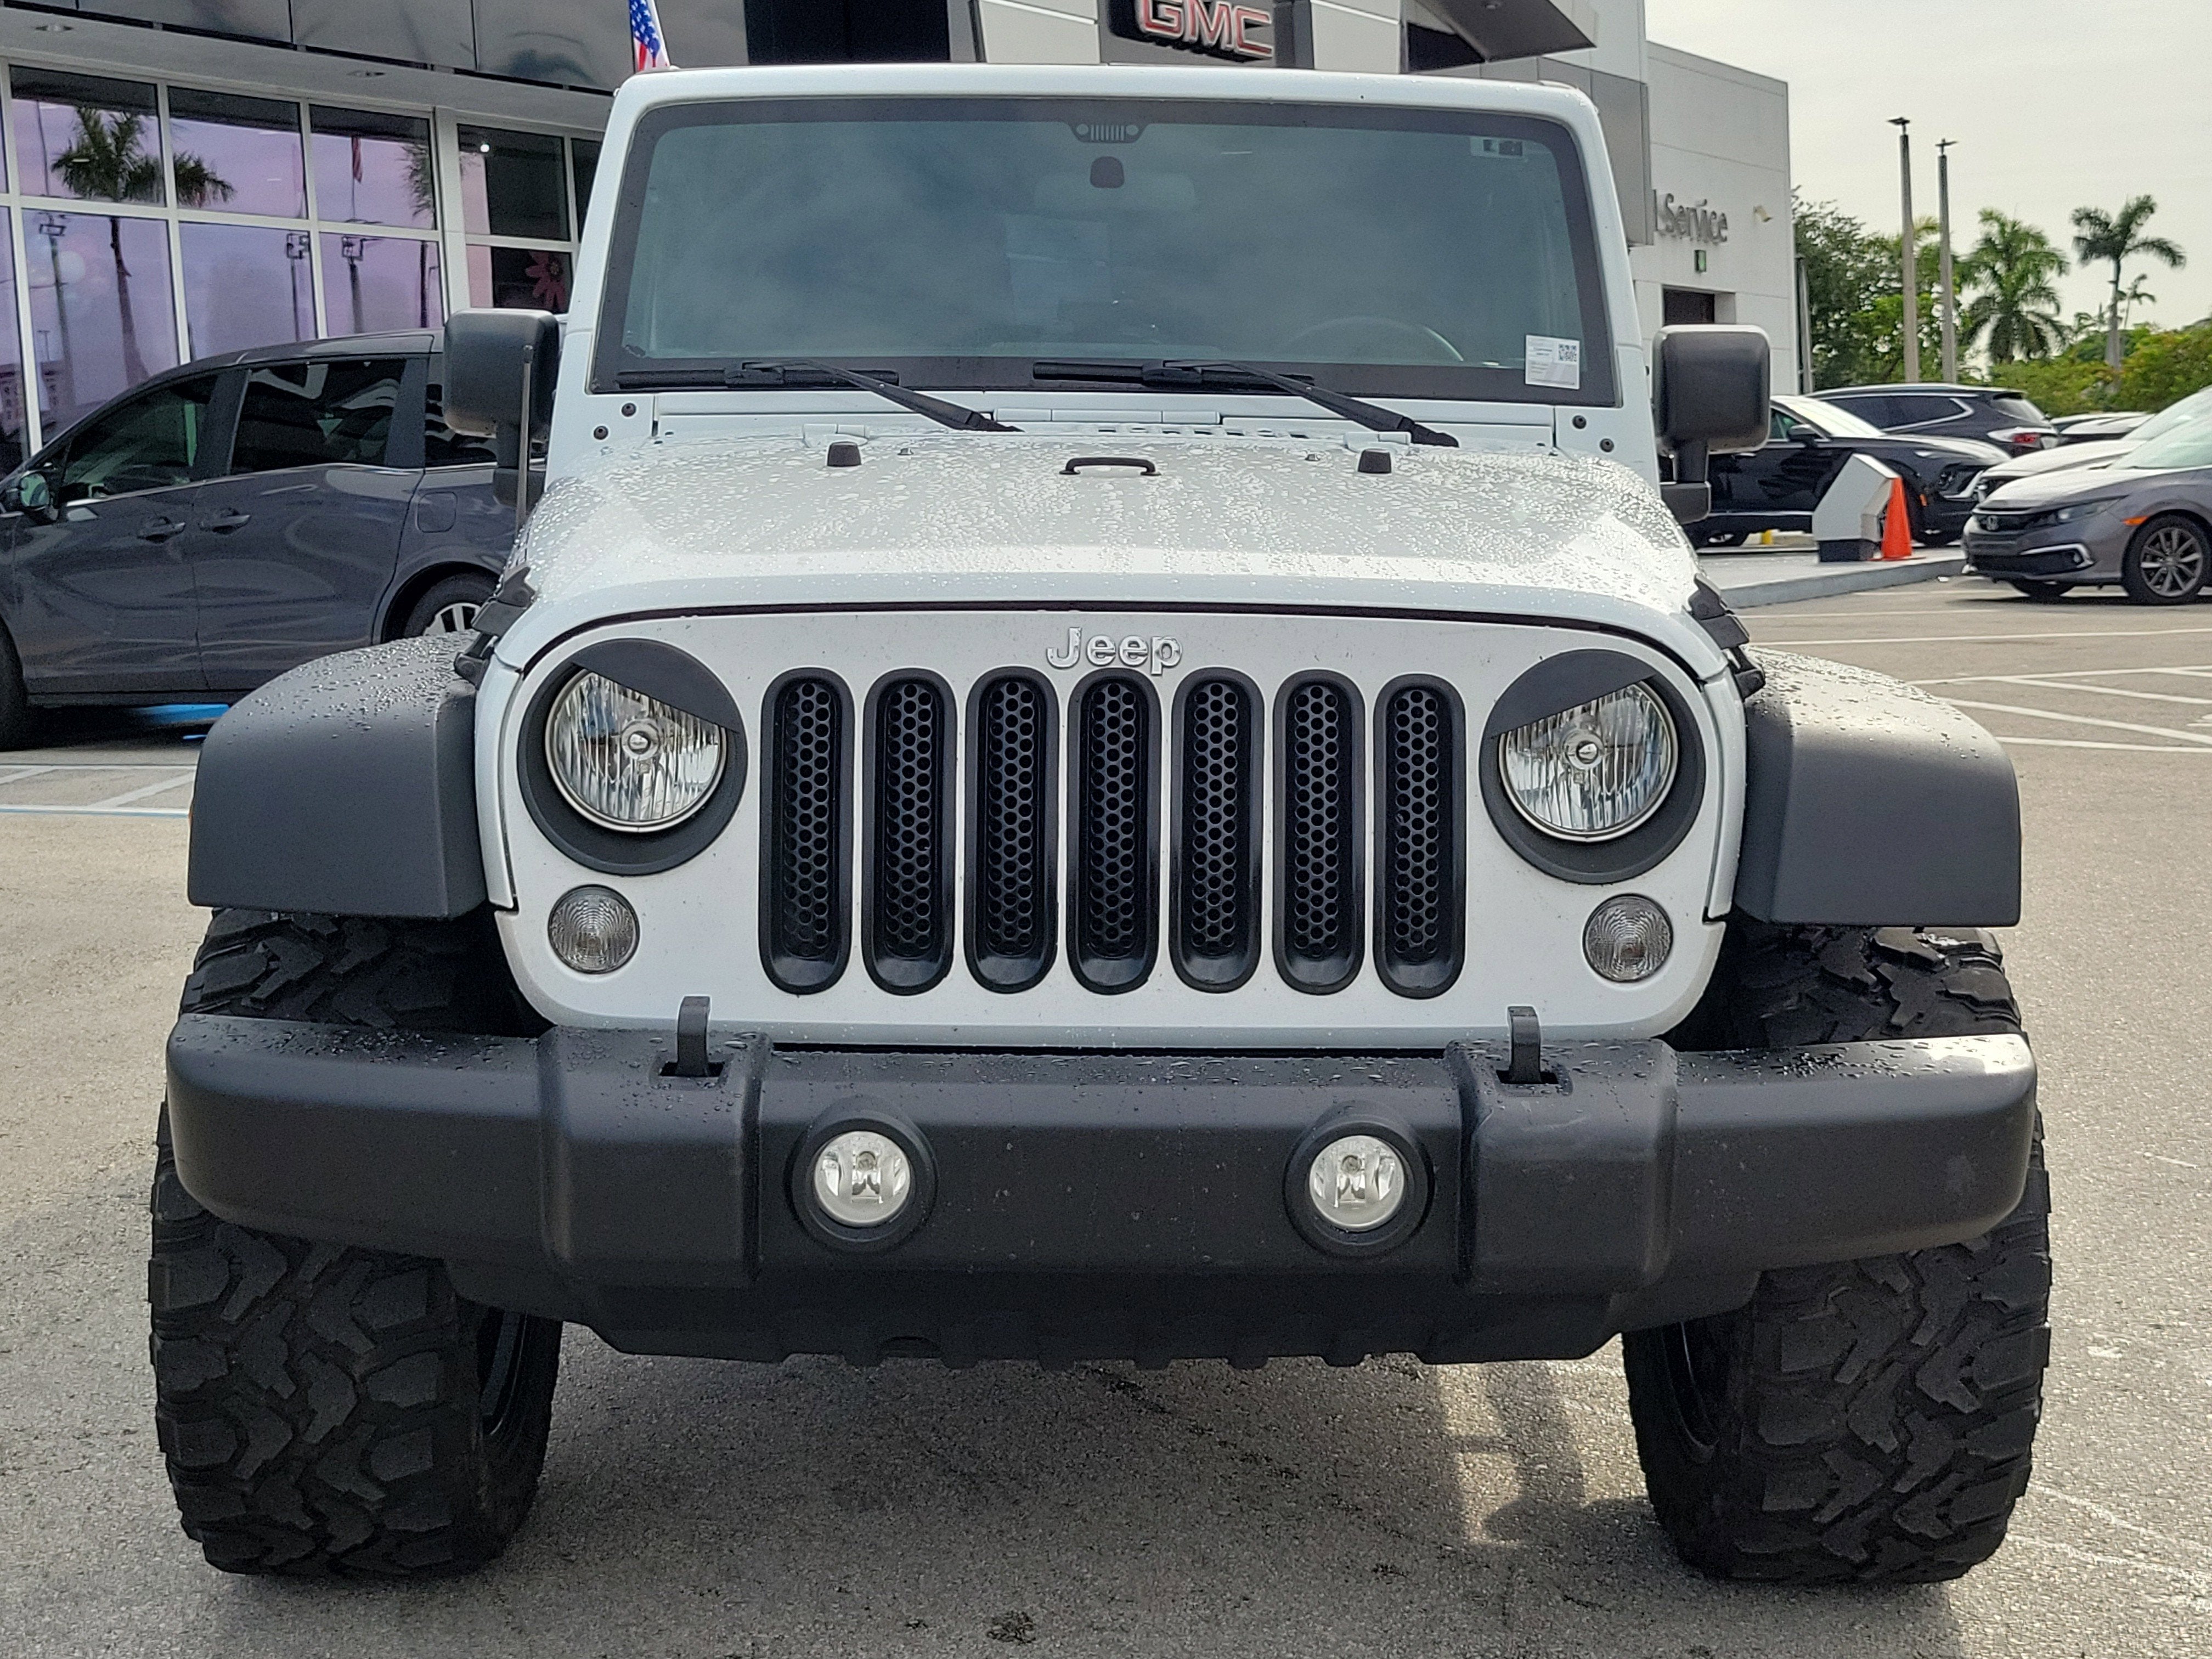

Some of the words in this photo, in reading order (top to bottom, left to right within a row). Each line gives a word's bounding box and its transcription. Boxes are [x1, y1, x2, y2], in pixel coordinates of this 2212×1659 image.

[1138, 0, 1272, 59] GMC
[1660, 193, 1728, 244] Service
[1046, 627, 1183, 676] Jeep
